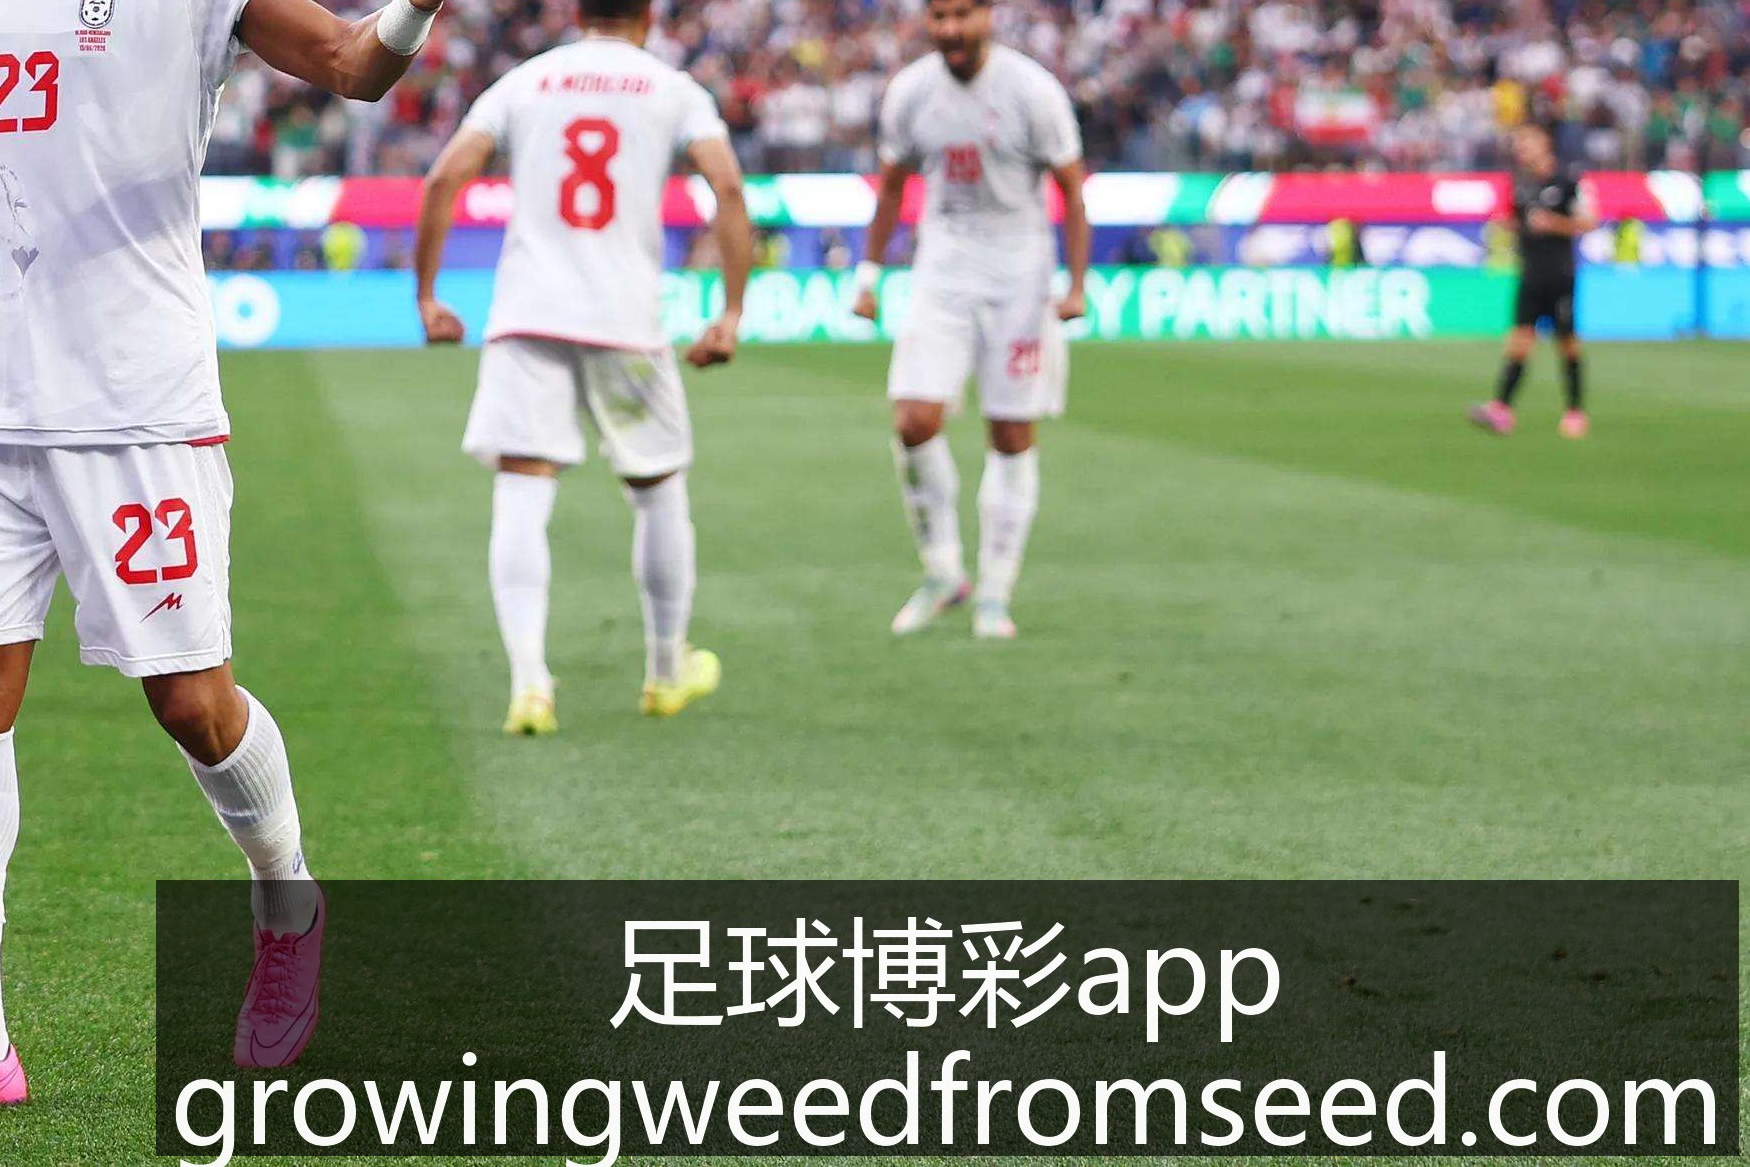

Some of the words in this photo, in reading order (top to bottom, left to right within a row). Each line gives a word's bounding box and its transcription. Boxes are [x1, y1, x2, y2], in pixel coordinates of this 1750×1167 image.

[559, 117, 620, 231] 8
[1138, 267, 1432, 341] PARTNER
[111, 497, 199, 586] 23
